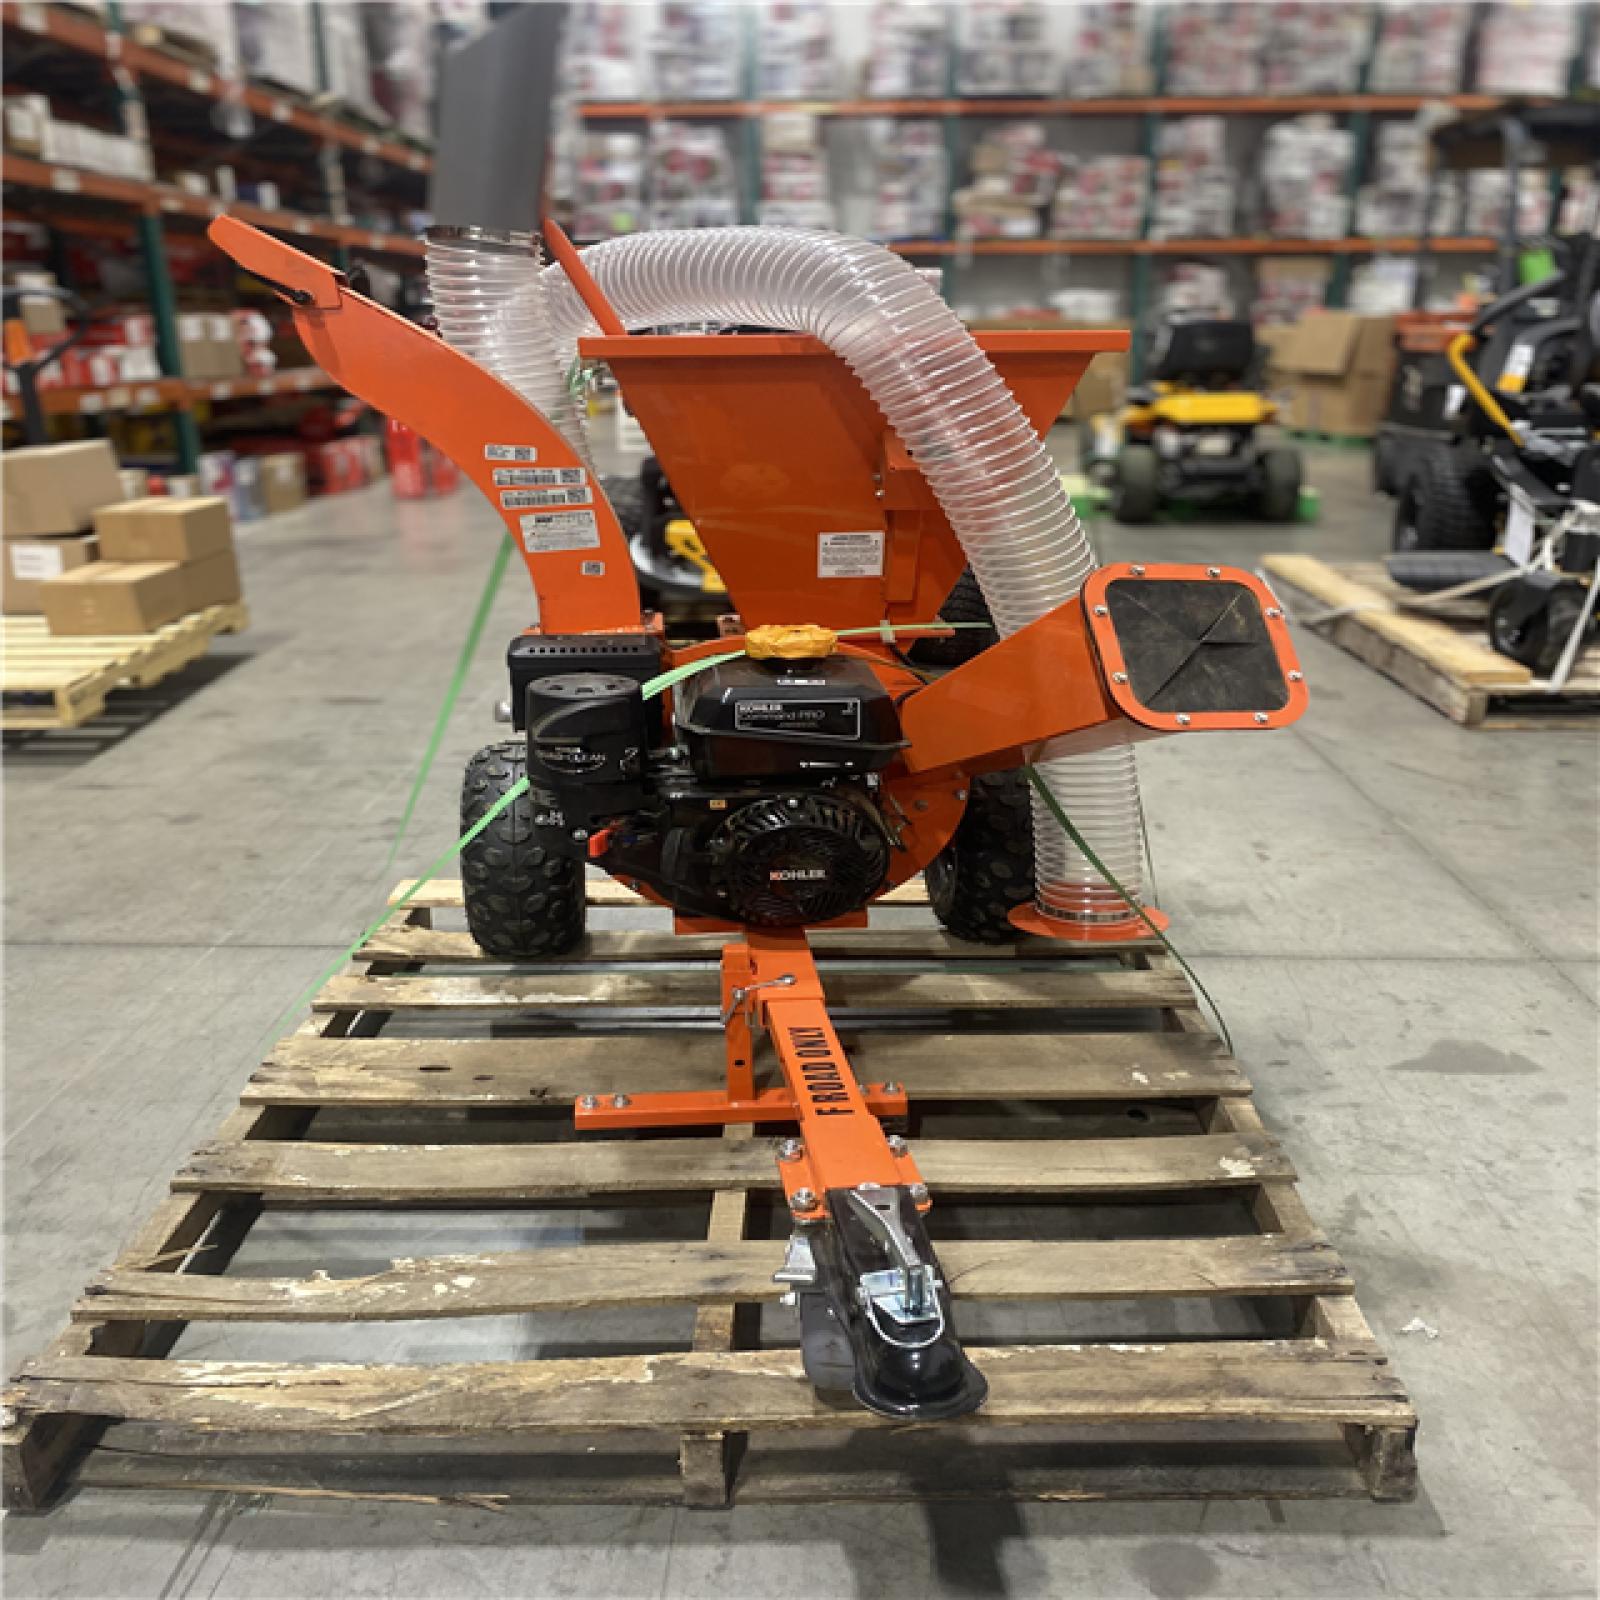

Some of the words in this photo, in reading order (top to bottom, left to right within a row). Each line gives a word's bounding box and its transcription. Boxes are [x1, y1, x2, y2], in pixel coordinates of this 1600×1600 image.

[769, 869, 826, 881] KOHLER
[788, 1027, 831, 1057] ONLY
[801, 1062, 850, 1103] ROAD
